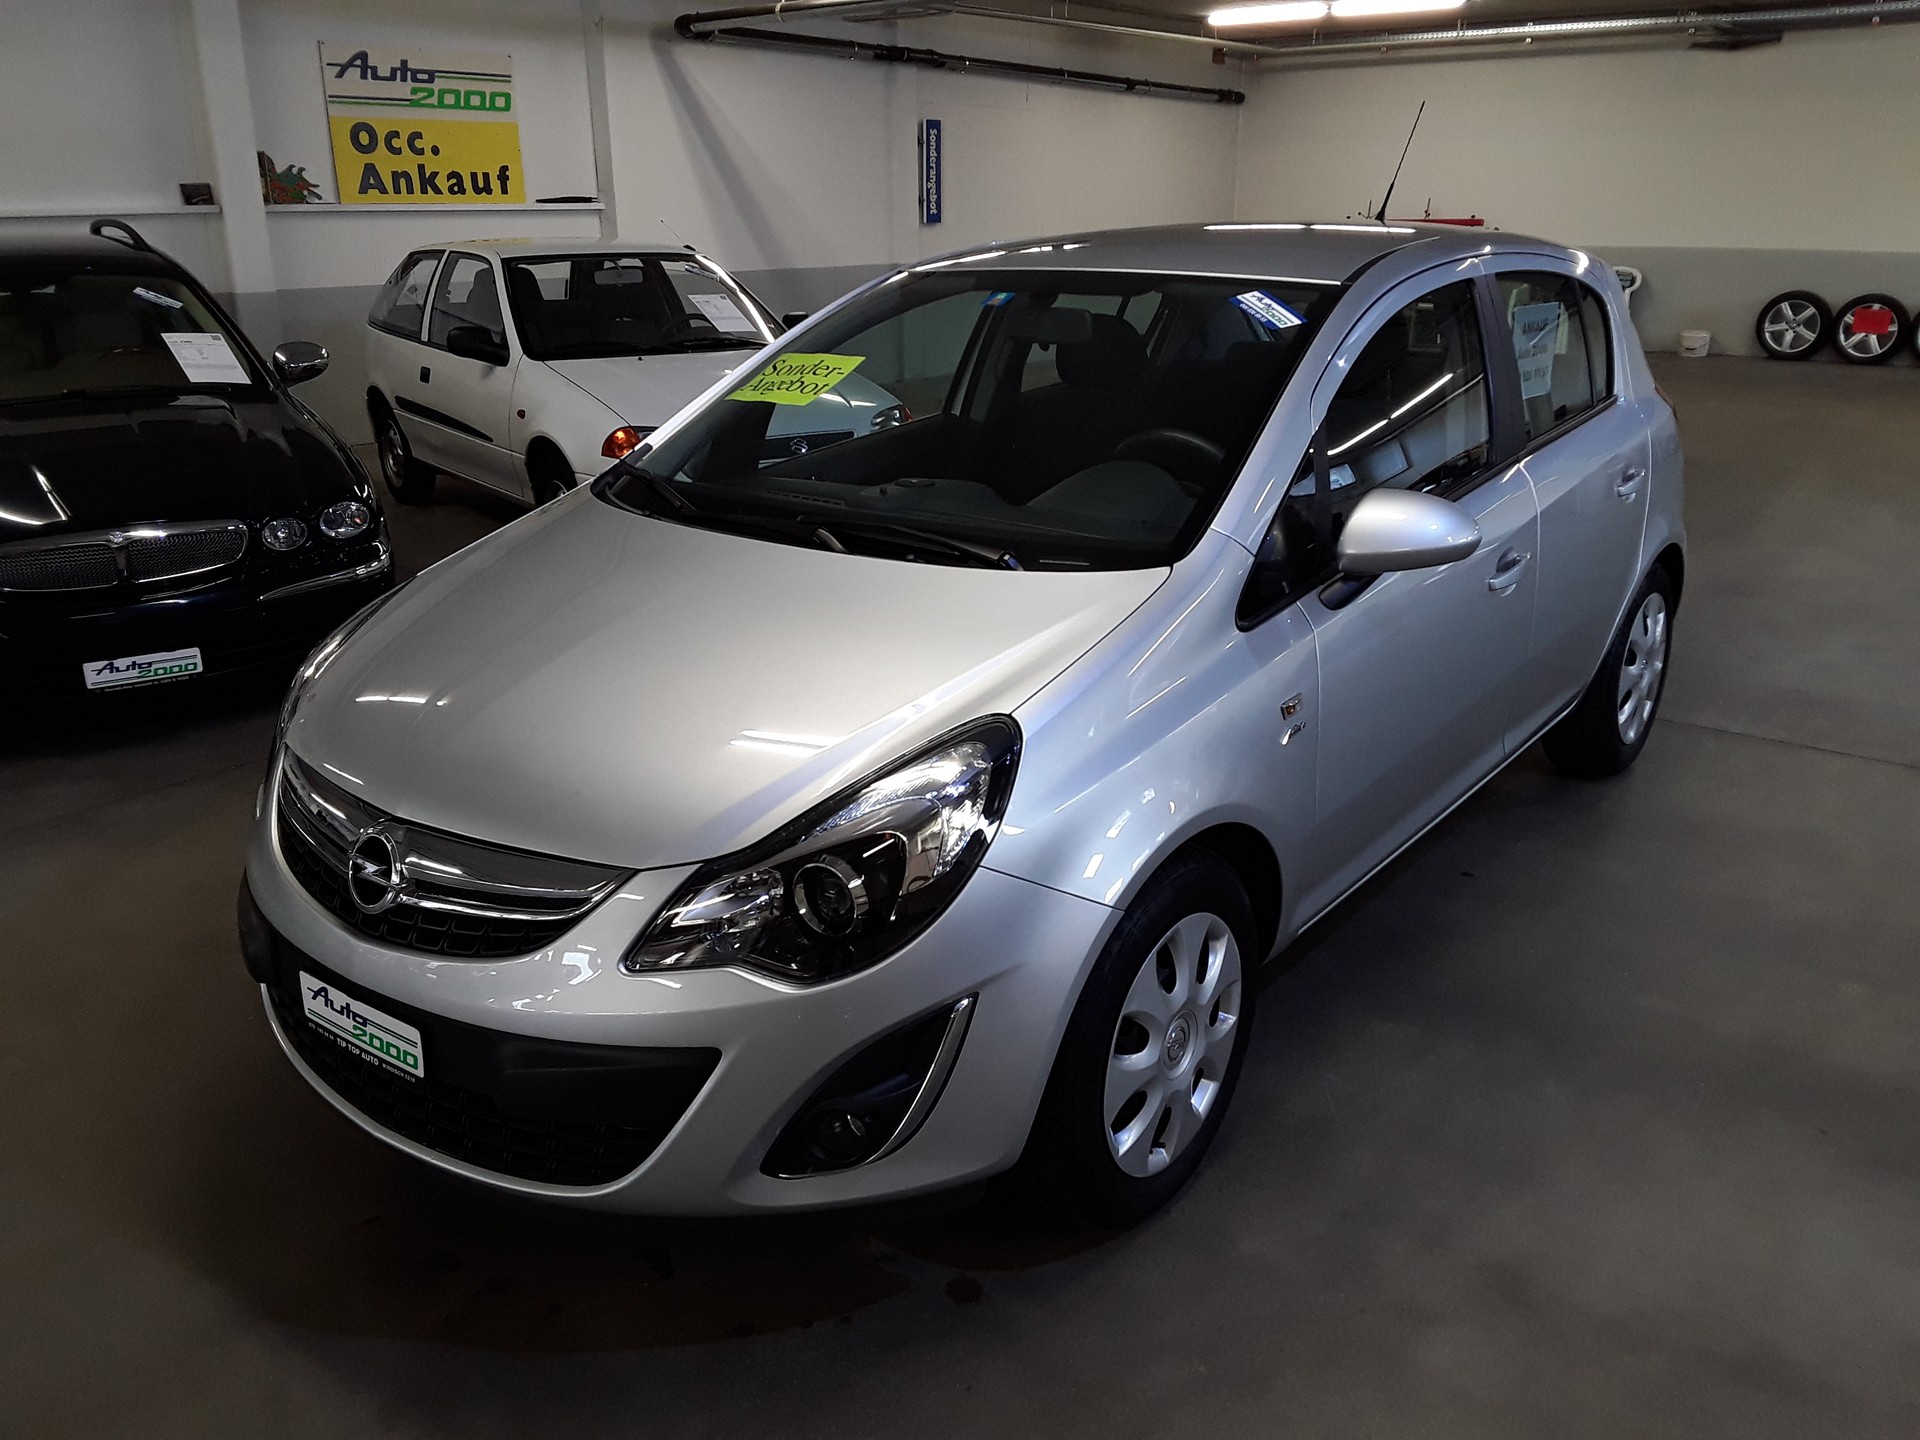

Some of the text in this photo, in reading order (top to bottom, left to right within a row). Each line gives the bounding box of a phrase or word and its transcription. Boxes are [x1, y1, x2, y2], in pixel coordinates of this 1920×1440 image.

[332, 49, 436, 84] Auto
[409, 86, 512, 113] 2000
[349, 121, 440, 157] Occ.
[357, 162, 510, 196] Ankauf
[926, 128, 938, 216] Sonderangebot
[762, 358, 845, 378] Sonder-
[740, 376, 830, 396] Angebot
[93, 660, 153, 677] Auto
[137, 661, 198, 679] 2000
[309, 986, 369, 1028] Auto
[336, 1037, 347, 1049] TIP
[347, 1042, 360, 1056] TOP
[361, 1051, 379, 1066] AUTO
[351, 1024, 419, 1071] 2000
